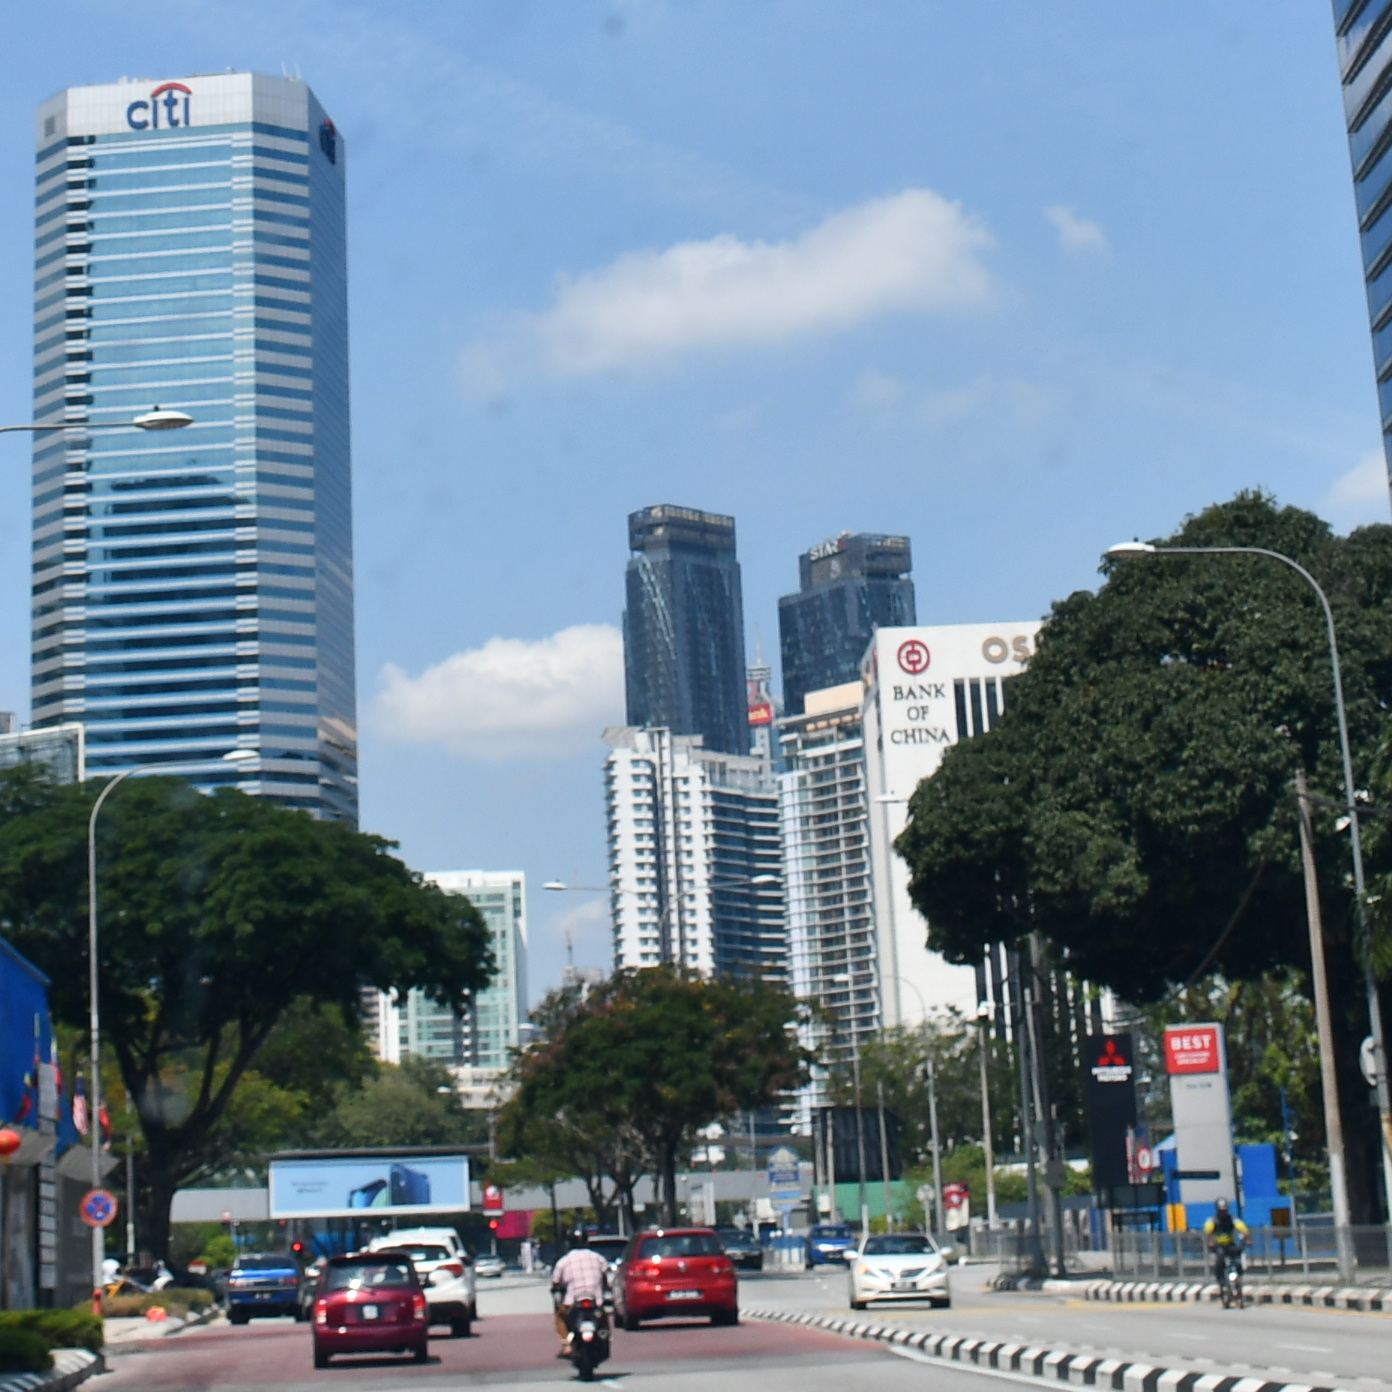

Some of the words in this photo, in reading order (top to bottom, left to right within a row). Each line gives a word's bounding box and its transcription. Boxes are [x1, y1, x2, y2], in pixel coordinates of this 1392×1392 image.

[126, 85, 191, 130] citi
[893, 683, 946, 701] BANK
[907, 706, 929, 721] OF
[890, 728, 951, 745] CHINA
[1170, 1034, 1212, 1050] BEST
